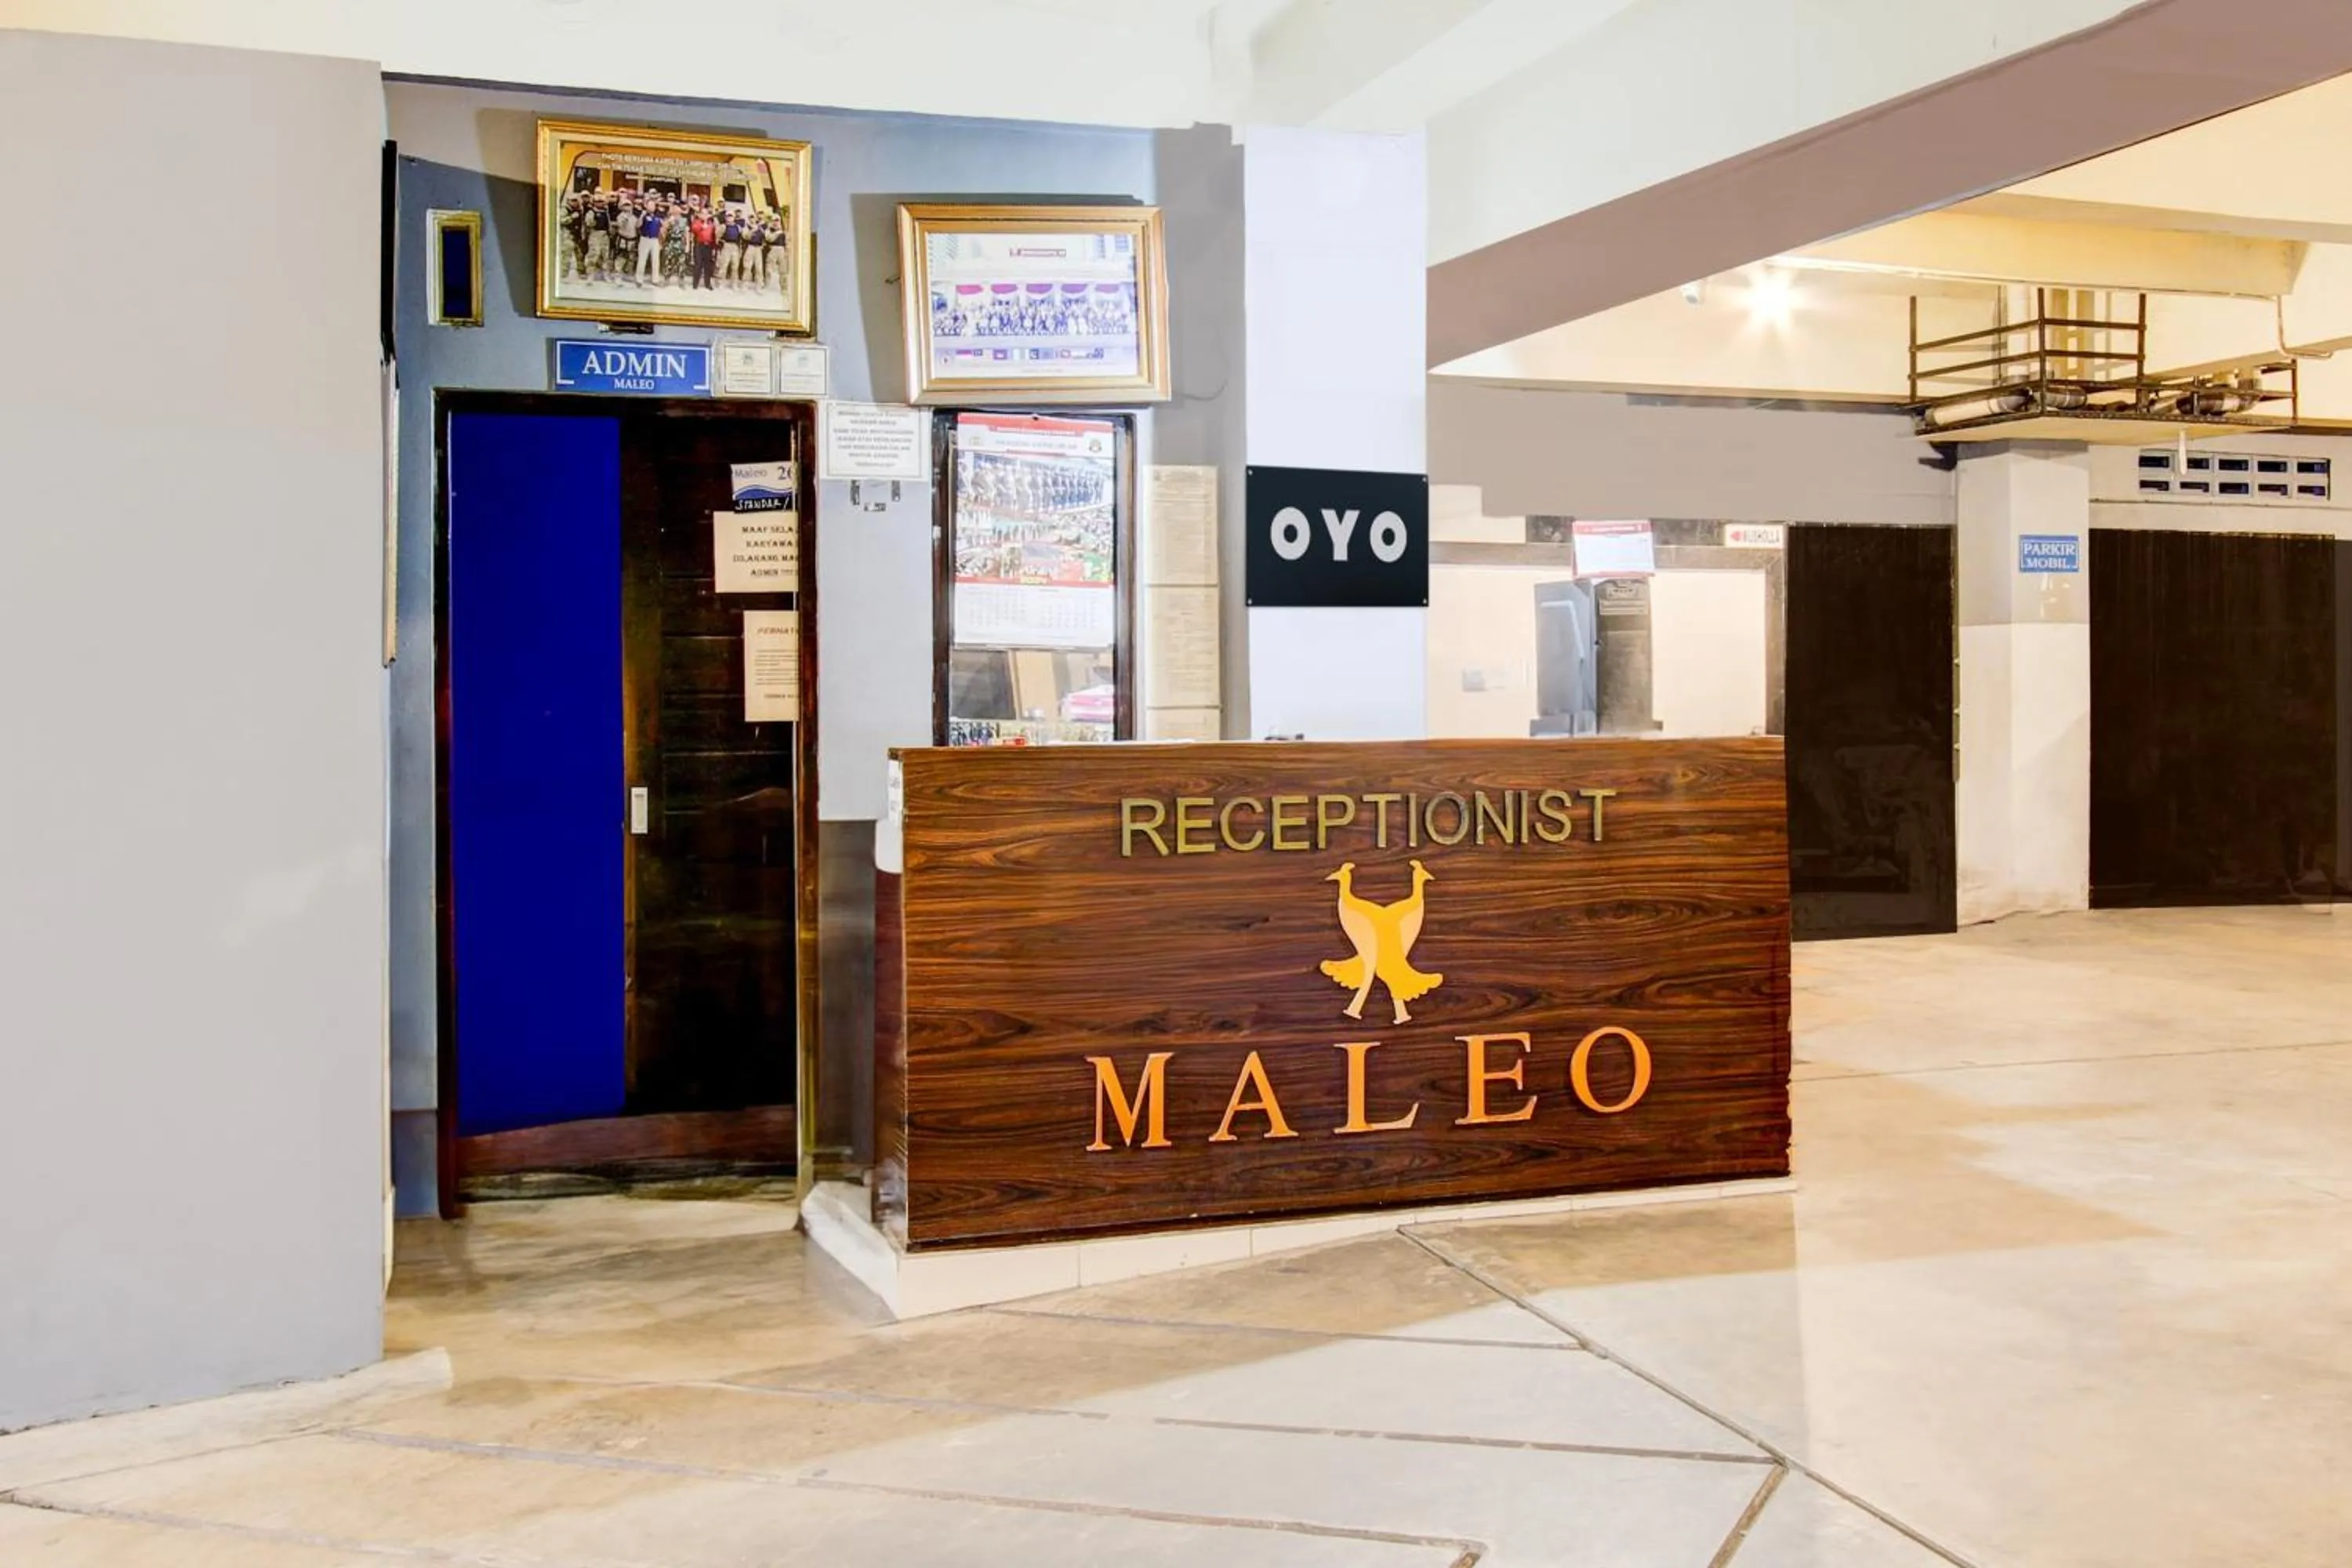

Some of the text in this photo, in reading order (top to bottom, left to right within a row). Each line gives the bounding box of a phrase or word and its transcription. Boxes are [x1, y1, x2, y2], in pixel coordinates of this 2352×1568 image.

[581, 350, 687, 378] ADMIN
[614, 378, 655, 390] MALEO
[746, 539, 798, 548] KARYAWA
[1270, 506, 1407, 563] OYO
[2024, 543, 2076, 557] PARKIR
[2025, 557, 2067, 568] MOBIL
[1120, 789, 1617, 857] RECEPTIONIST
[1086, 1026, 1652, 1152] MALEO
